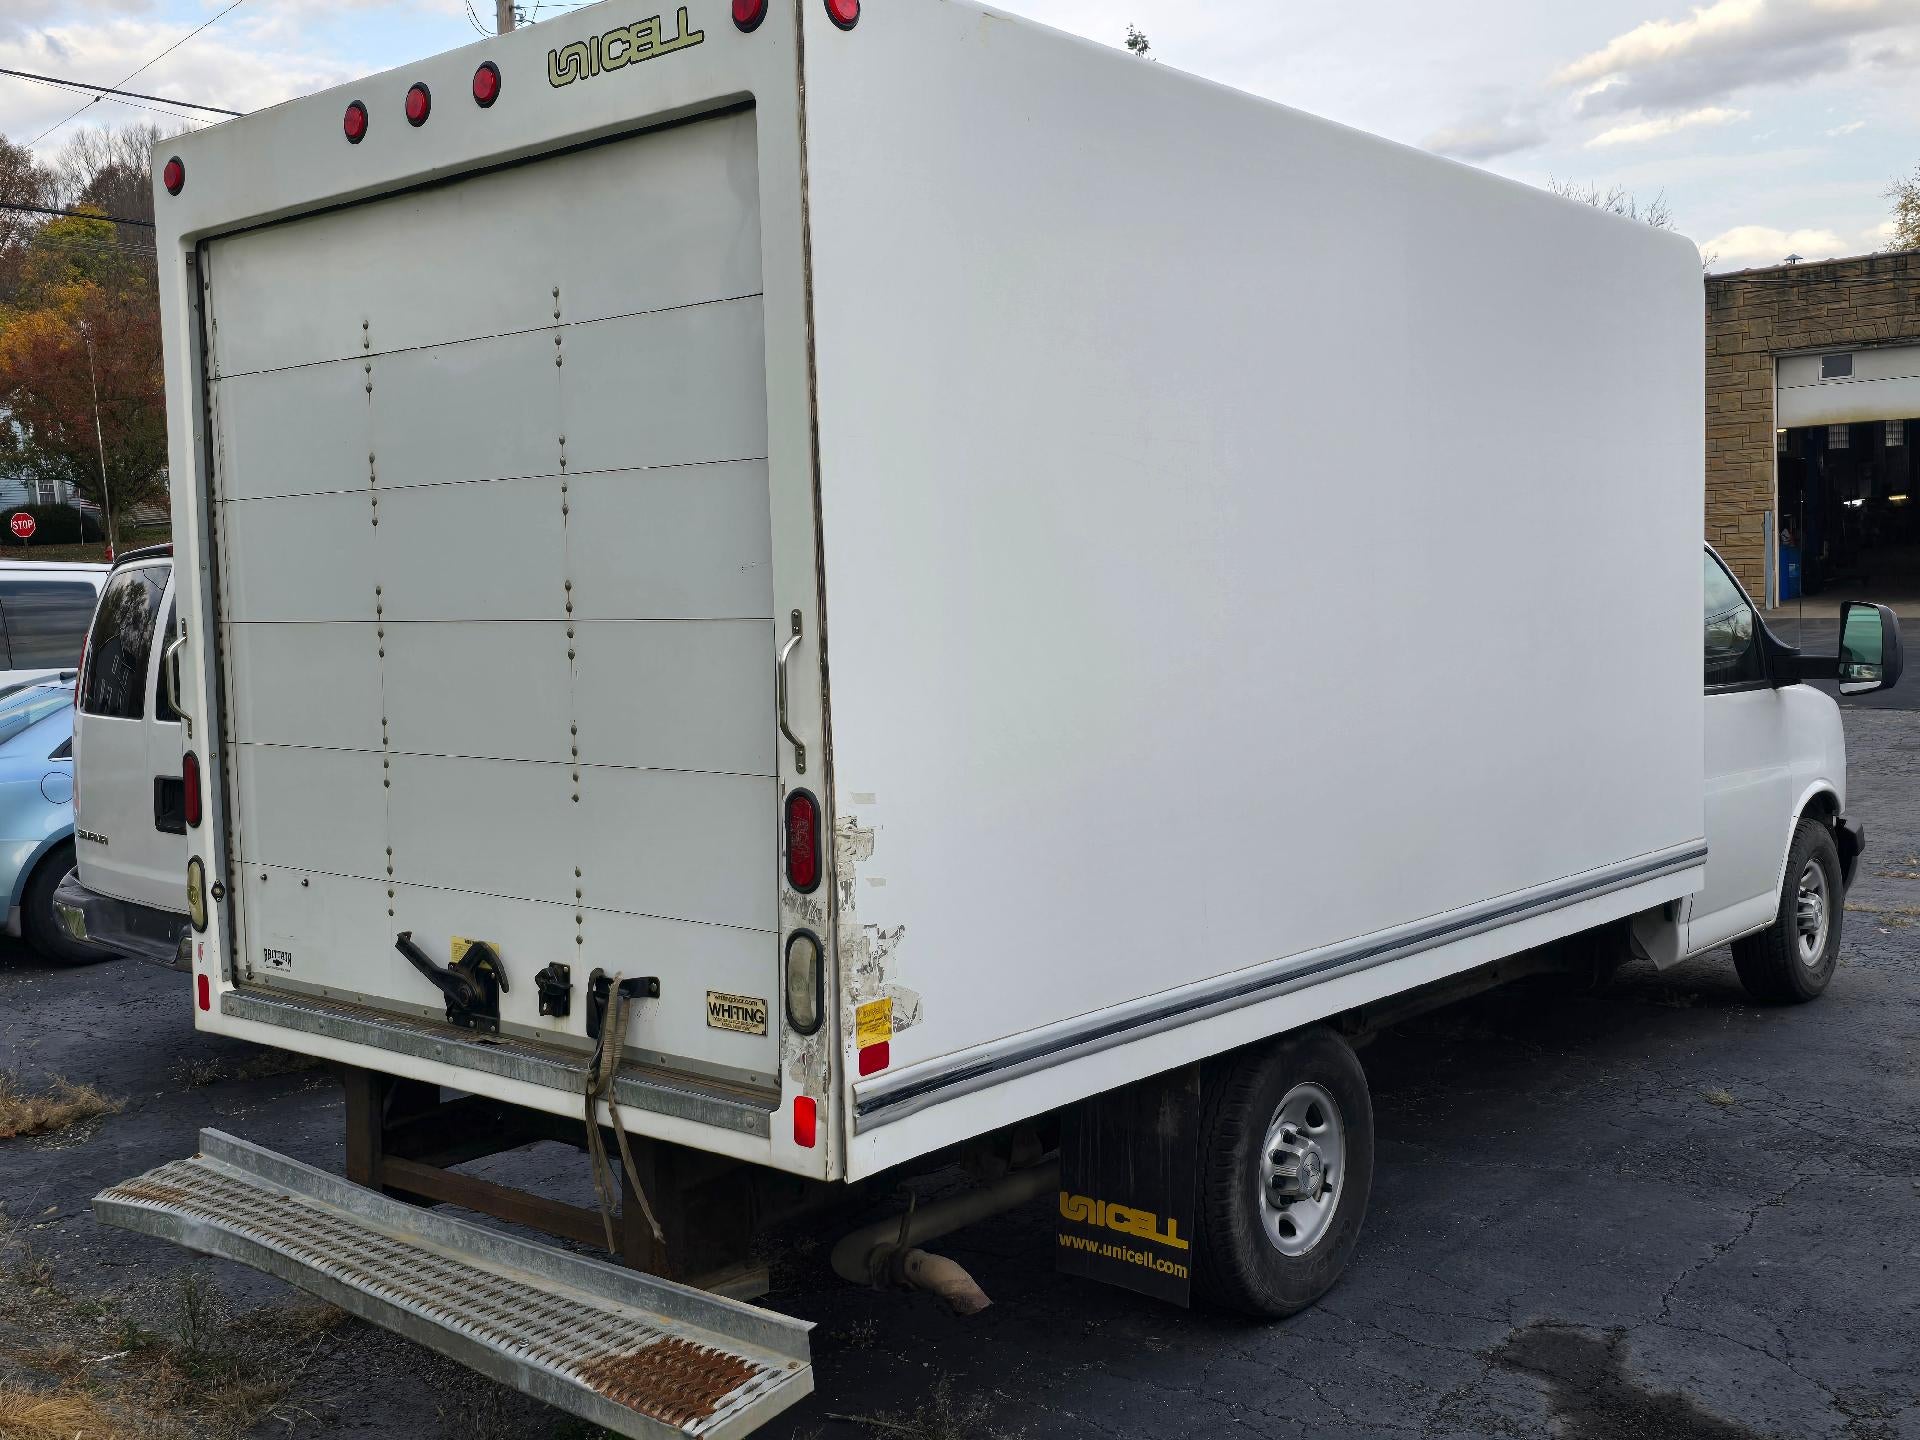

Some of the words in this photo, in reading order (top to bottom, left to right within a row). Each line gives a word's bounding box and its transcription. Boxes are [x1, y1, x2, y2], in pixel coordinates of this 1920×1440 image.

[548, 6, 704, 88] UNICELL
[12, 520, 33, 530] STOP
[708, 1001, 765, 1024] WHITING
[1059, 1191, 1189, 1250] UNICELL
[1059, 1233, 1188, 1279] www.unicell.com
